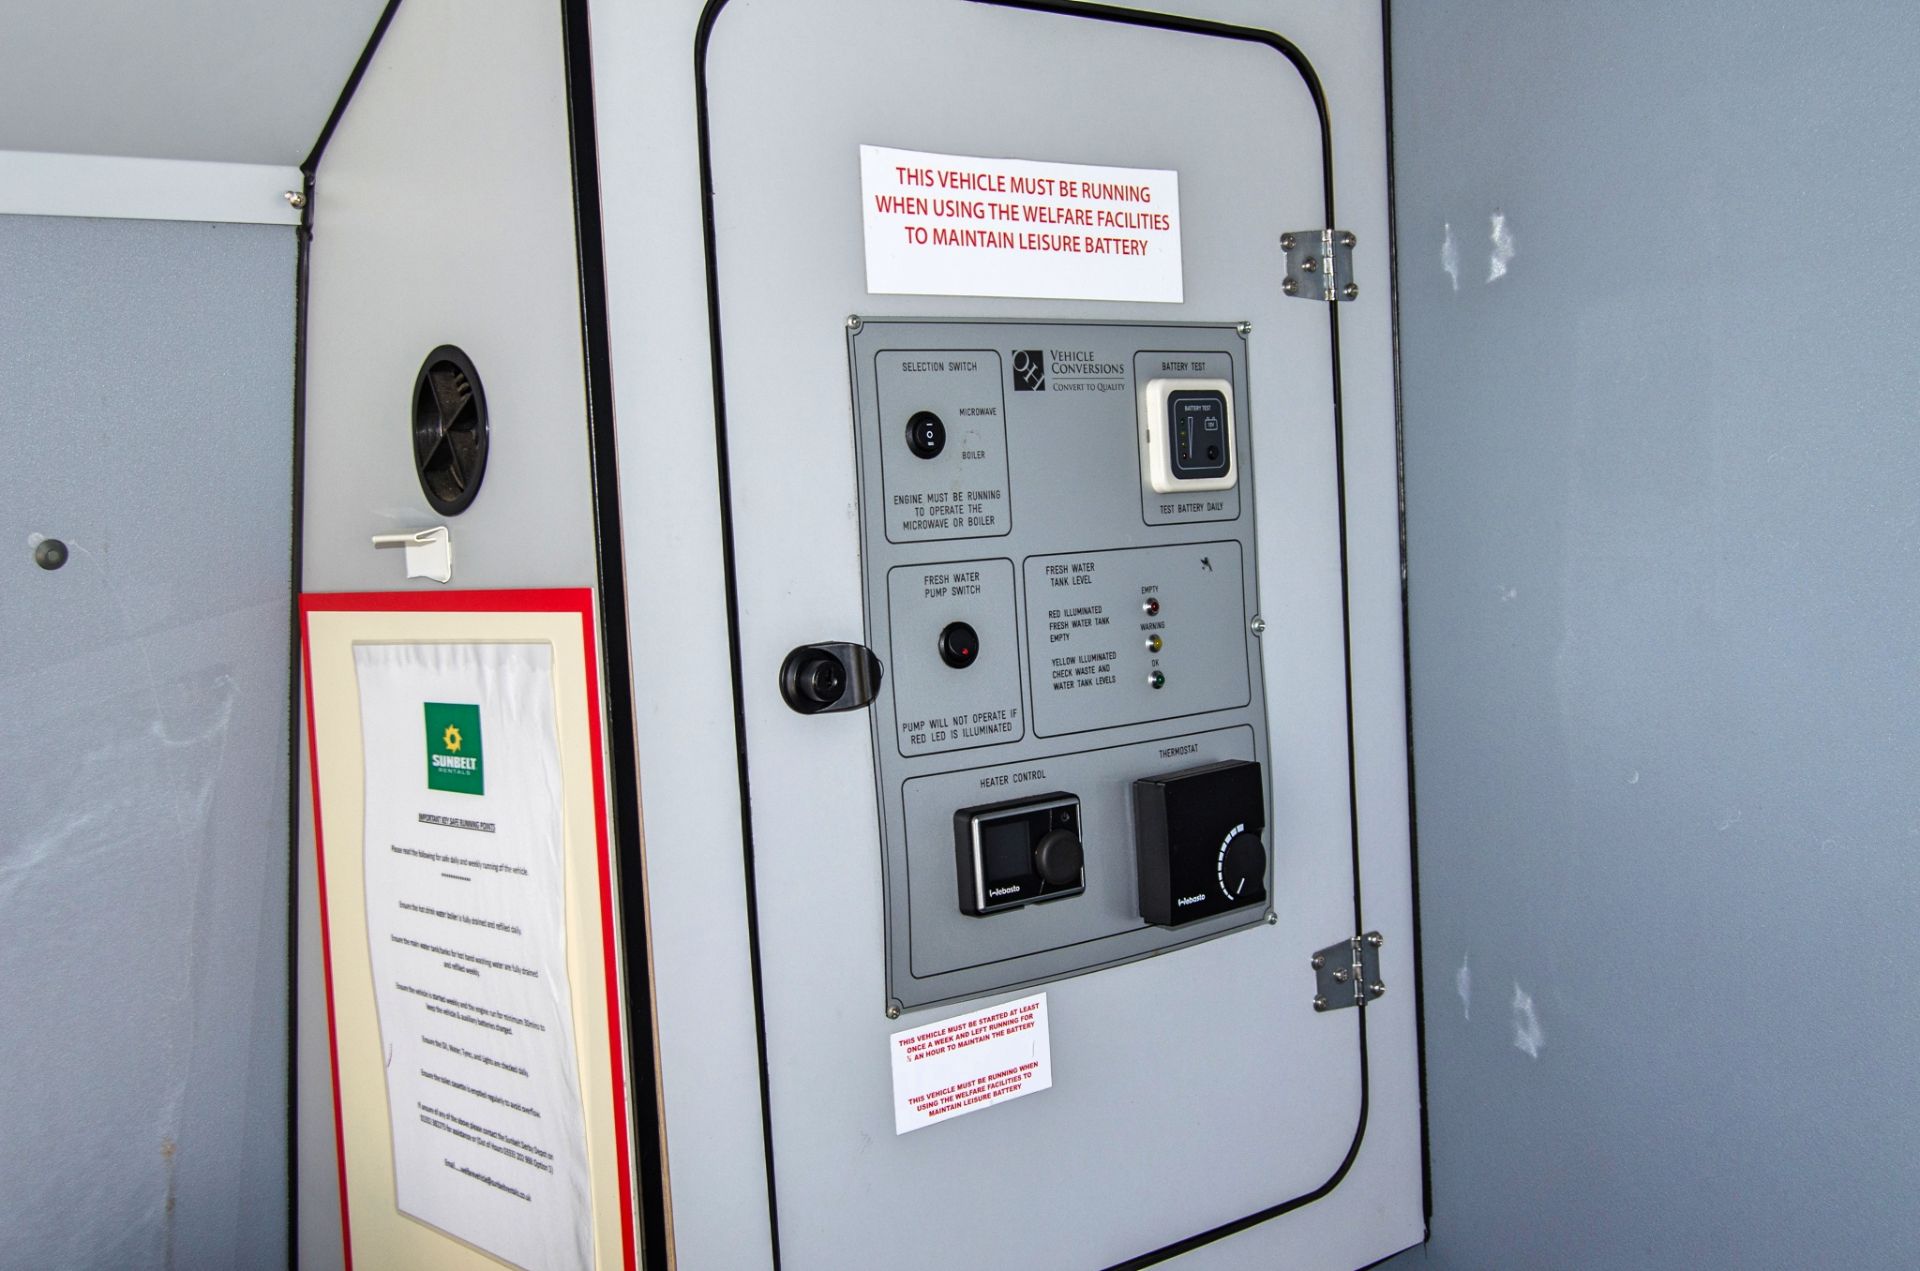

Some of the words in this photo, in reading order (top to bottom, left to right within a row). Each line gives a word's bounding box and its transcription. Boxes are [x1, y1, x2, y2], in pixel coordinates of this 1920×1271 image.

[895, 166, 934, 187] THIS
[937, 170, 1006, 193] VEHICLE
[1010, 176, 1055, 196] MUST
[1059, 180, 1077, 198] BE
[1081, 181, 1150, 203] RUNNING
[874, 194, 928, 216] WHEN
[932, 198, 985, 219] USING
[987, 202, 1019, 221] THE
[1022, 205, 1093, 226] WELFARE
[1097, 210, 1170, 231] FACILITIES
[904, 226, 928, 245] TO
[932, 227, 1014, 249] MAINTAIN
[1018, 232, 1081, 252] LEISURE
[1084, 236, 1148, 256] BATTERY
[1050, 350, 1094, 362] VEHICLE
[901, 361, 944, 372] SELECTION
[948, 361, 977, 371] SWITCH
[1052, 362, 1124, 374] CONVERSIONS
[1161, 361, 1188, 371] BATTERY
[1190, 361, 1205, 371] TEST
[1052, 383, 1084, 391] CONVERT
[1086, 383, 1096, 391] TO
[1096, 382, 1125, 392] QUALITY
[959, 407, 996, 416] MICROWAVE
[961, 450, 985, 460] BOILER
[893, 493, 922, 505] ENGINE
[927, 492, 948, 503] MUST
[952, 491, 963, 502] BE
[967, 489, 1001, 501] RUNNING
[914, 506, 925, 517] TO
[929, 504, 964, 518] OPERATE
[967, 503, 982, 516] THE
[1159, 504, 1174, 514] TEST
[1177, 502, 1204, 513] BATTERY
[1206, 501, 1223, 511] DAILY
[902, 518, 949, 531] MICROWAVE
[952, 517, 963, 527] OR
[967, 515, 995, 526] BOILER
[1045, 564, 1068, 575] FRESH
[1071, 561, 1095, 575] WATER
[923, 574, 949, 585] FRESH
[952, 571, 979, 585] WATER
[1050, 576, 1069, 586] TANK
[1071, 574, 1092, 585] LEVEL
[924, 586, 947, 598] PUMP
[951, 584, 980, 596] SWITCH
[1140, 585, 1158, 595] EMPTY
[1048, 609, 1060, 619] RED
[1063, 605, 1102, 617] ILLUMINATED
[1049, 620, 1069, 631] FRESH
[1071, 618, 1092, 628] WATER
[1094, 616, 1110, 625] TANK
[1140, 621, 1165, 631] WARNING
[1049, 632, 1069, 643] EMPTY
[1051, 656, 1075, 667] YELLOW
[1078, 651, 1116, 664] ILLUMINATED
[1151, 658, 1159, 667] OK
[1052, 668, 1073, 679] CHECK
[1074, 665, 1095, 676] WASTE
[1097, 663, 1110, 673] AND
[1052, 680, 1074, 691] WATER
[1076, 678, 1093, 687] TANK
[1095, 675, 1116, 685] LEVELS
[902, 720, 925, 733] PUMP
[928, 717, 948, 729] WILL
[952, 714, 968, 726] NOT
[972, 709, 1006, 725] OPERATE
[1010, 708, 1017, 718] IF
[910, 733, 926, 745] RED
[931, 730, 946, 742] LED
[950, 728, 958, 740] IS
[962, 721, 1012, 738] ILLUMINATED
[1158, 743, 1198, 759] THERMOSTAT
[432, 754, 477, 770] SUNBELT
[979, 774, 1009, 789] HEATER
[1012, 768, 1046, 783] CONTROL
[898, 1037, 915, 1046] THIS
[916, 1028, 945, 1042] VEHICLE
[947, 1023, 966, 1033] MUST
[968, 1020, 977, 1028] BE
[978, 1011, 1008, 1025] STARTED
[1009, 1009, 1017, 1018] AT
[1019, 1003, 1039, 1015] LEAST
[906, 1043, 925, 1053] ONCE
[934, 1035, 953, 1046] WEEK
[955, 1031, 969, 1040] AND
[971, 1026, 987, 1035] LEFT
[988, 1017, 1020, 1032] RUNNING
[1019, 1014, 1033, 1024] FOR
[914, 1052, 924, 1060] AN
[925, 1046, 945, 1057] HOUR
[946, 1043, 956, 1051] TO
[957, 1034, 990, 1048] MAINTAIN
[991, 1030, 1004, 1038] THE
[1006, 1022, 1034, 1034] BATTERY
[908, 1095, 924, 1105] THIS
[926, 1085, 955, 1100] VEHICLE
[956, 1080, 975, 1090] MUST
[977, 1076, 986, 1084] BE
[987, 1067, 1018, 1083] RUNNING
[1019, 1061, 1038, 1074] WHEN
[916, 1100, 938, 1111] USING
[940, 1095, 953, 1104] THE
[954, 1085, 985, 1101] WELFARE
[987, 1075, 1021, 1092] FACILITIES
[928, 1101, 961, 1117] MAINTAIN
[963, 1093, 991, 1106] LEISURE
[992, 1084, 1021, 1097] BATTERY
